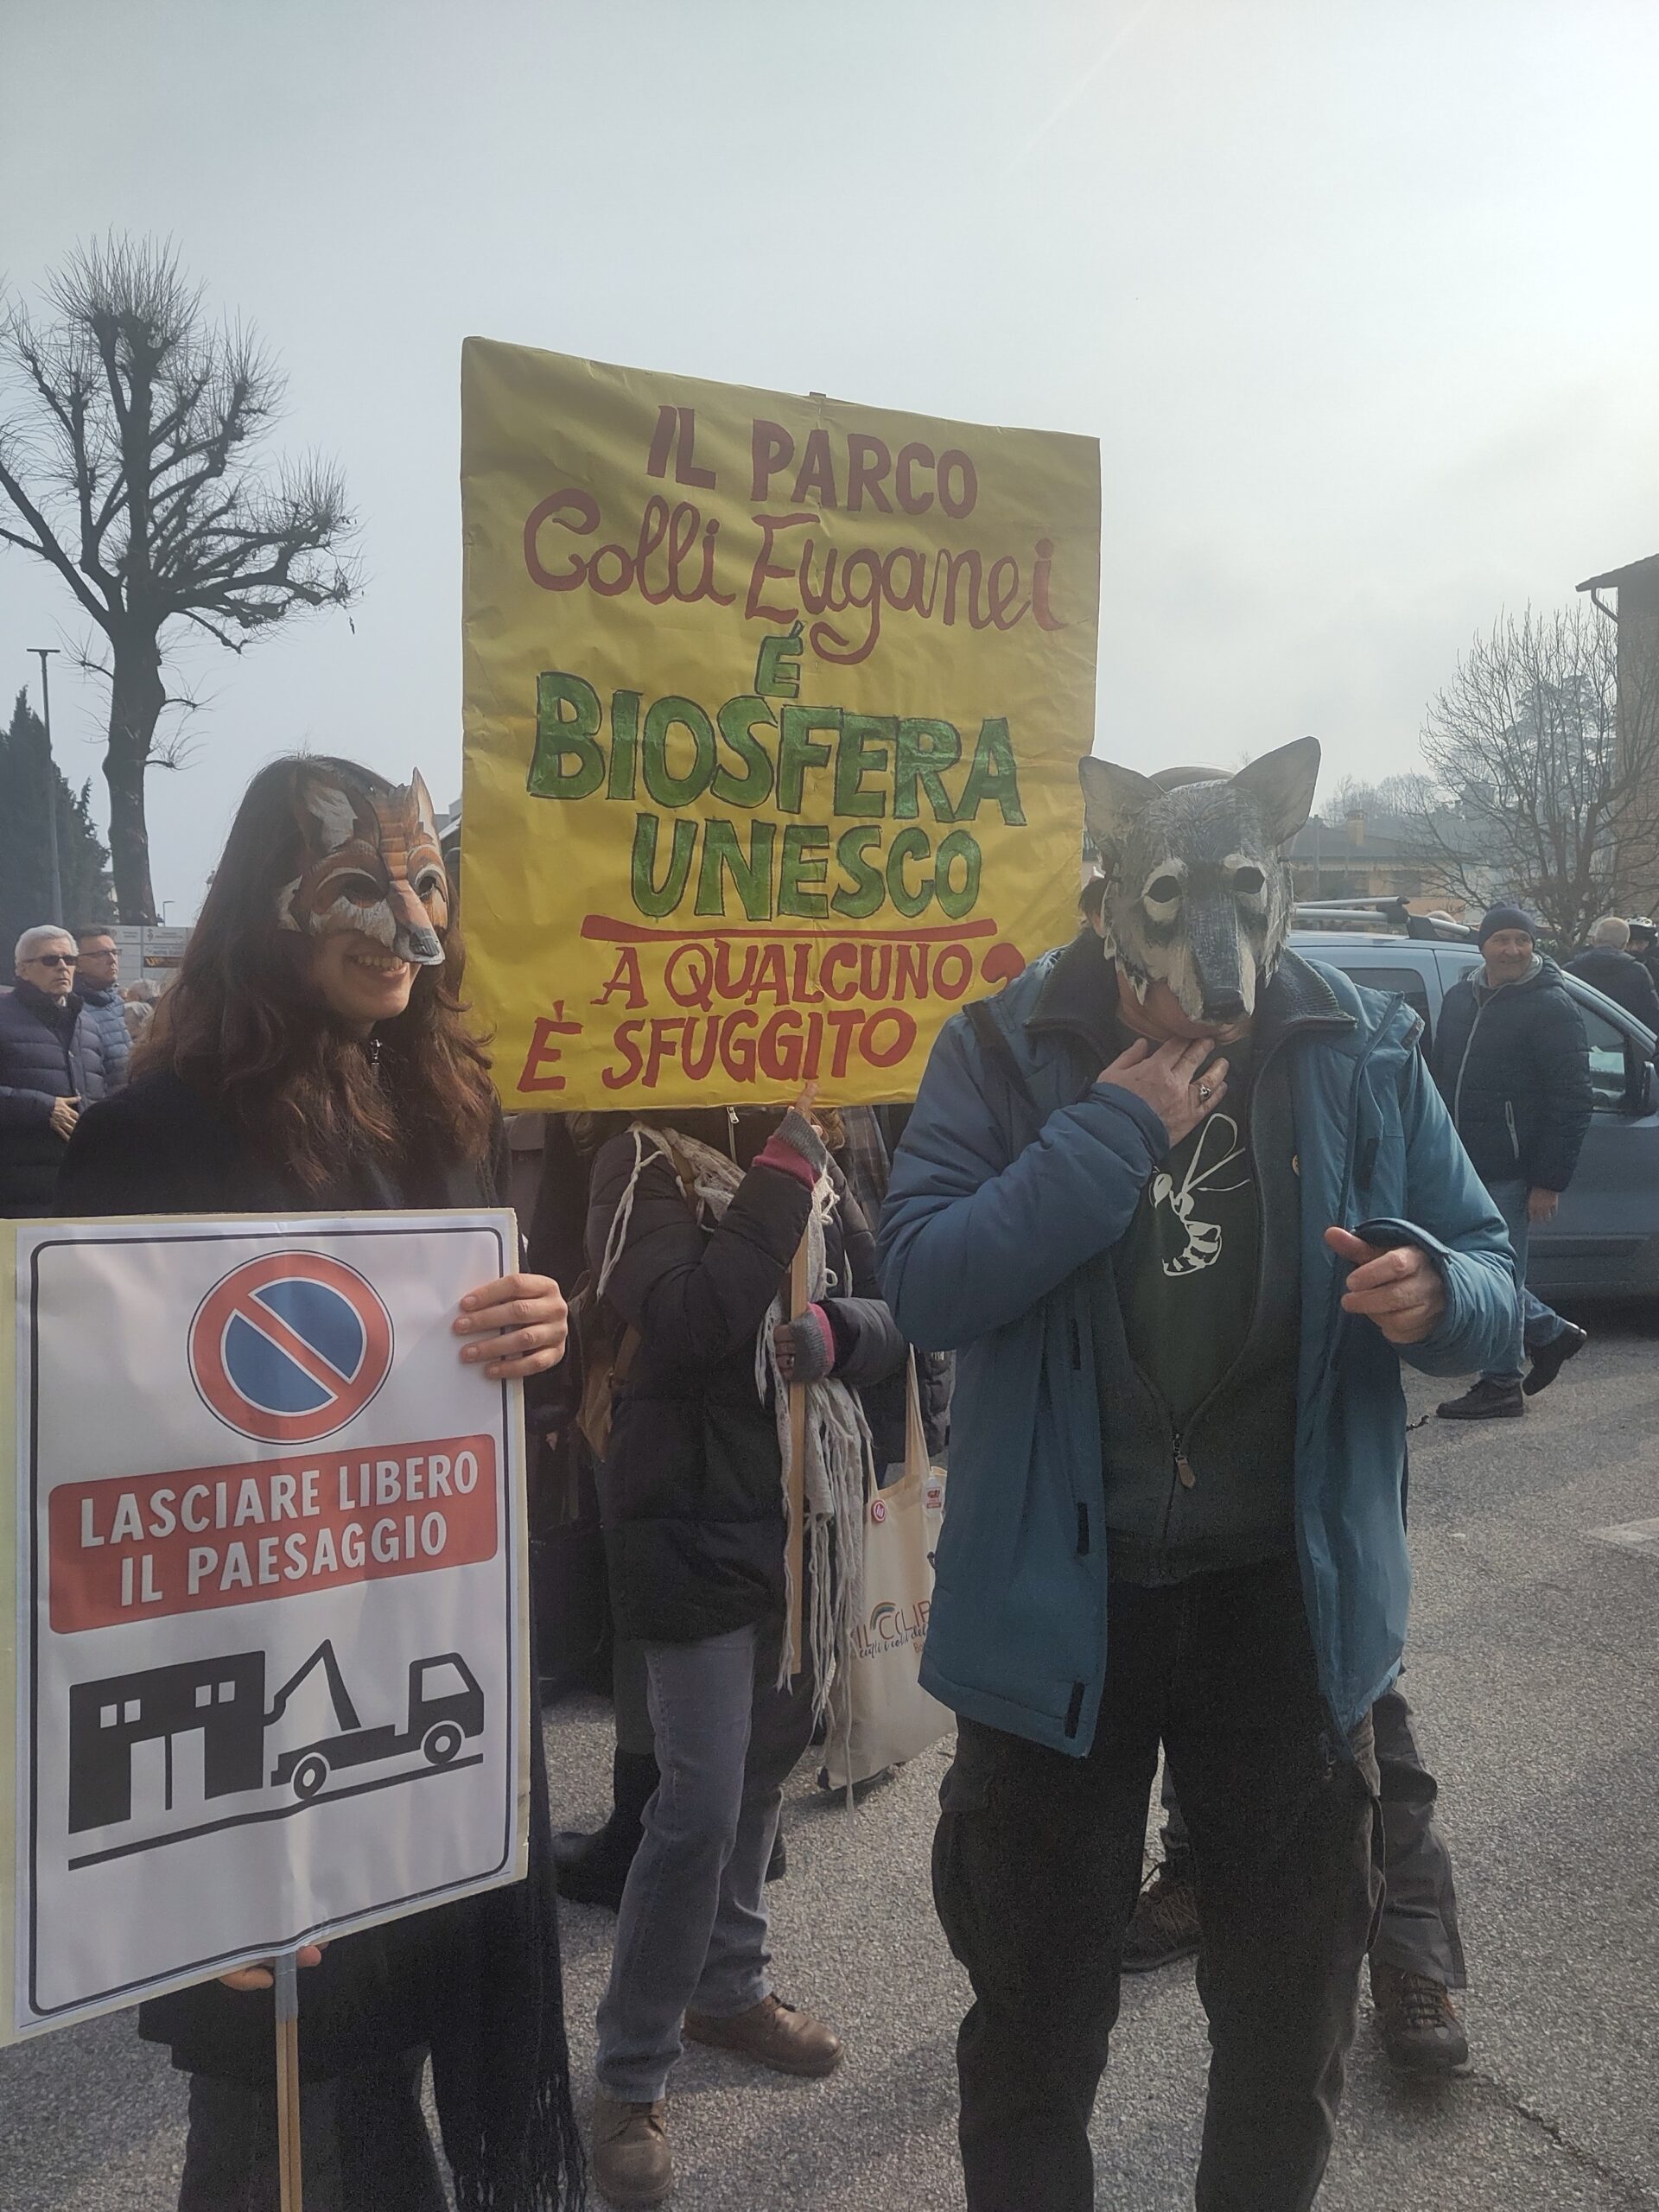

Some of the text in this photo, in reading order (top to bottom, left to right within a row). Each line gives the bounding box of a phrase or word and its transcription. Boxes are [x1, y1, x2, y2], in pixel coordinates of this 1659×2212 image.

[646, 405, 977, 519] IL PARCO
[523, 488, 1068, 664] Colli Euganei
[527, 672, 1027, 825] BIOSFERA
[631, 814, 982, 921] UNESCO
[590, 947, 648, 1008] A
[664, 939, 973, 1013] QUALCUNO
[602, 1008, 917, 1090] SFUGGITO
[81, 1451, 478, 1548] LASCIARE LIBERO
[121, 1511, 447, 1606] IL PAESAGGIO
